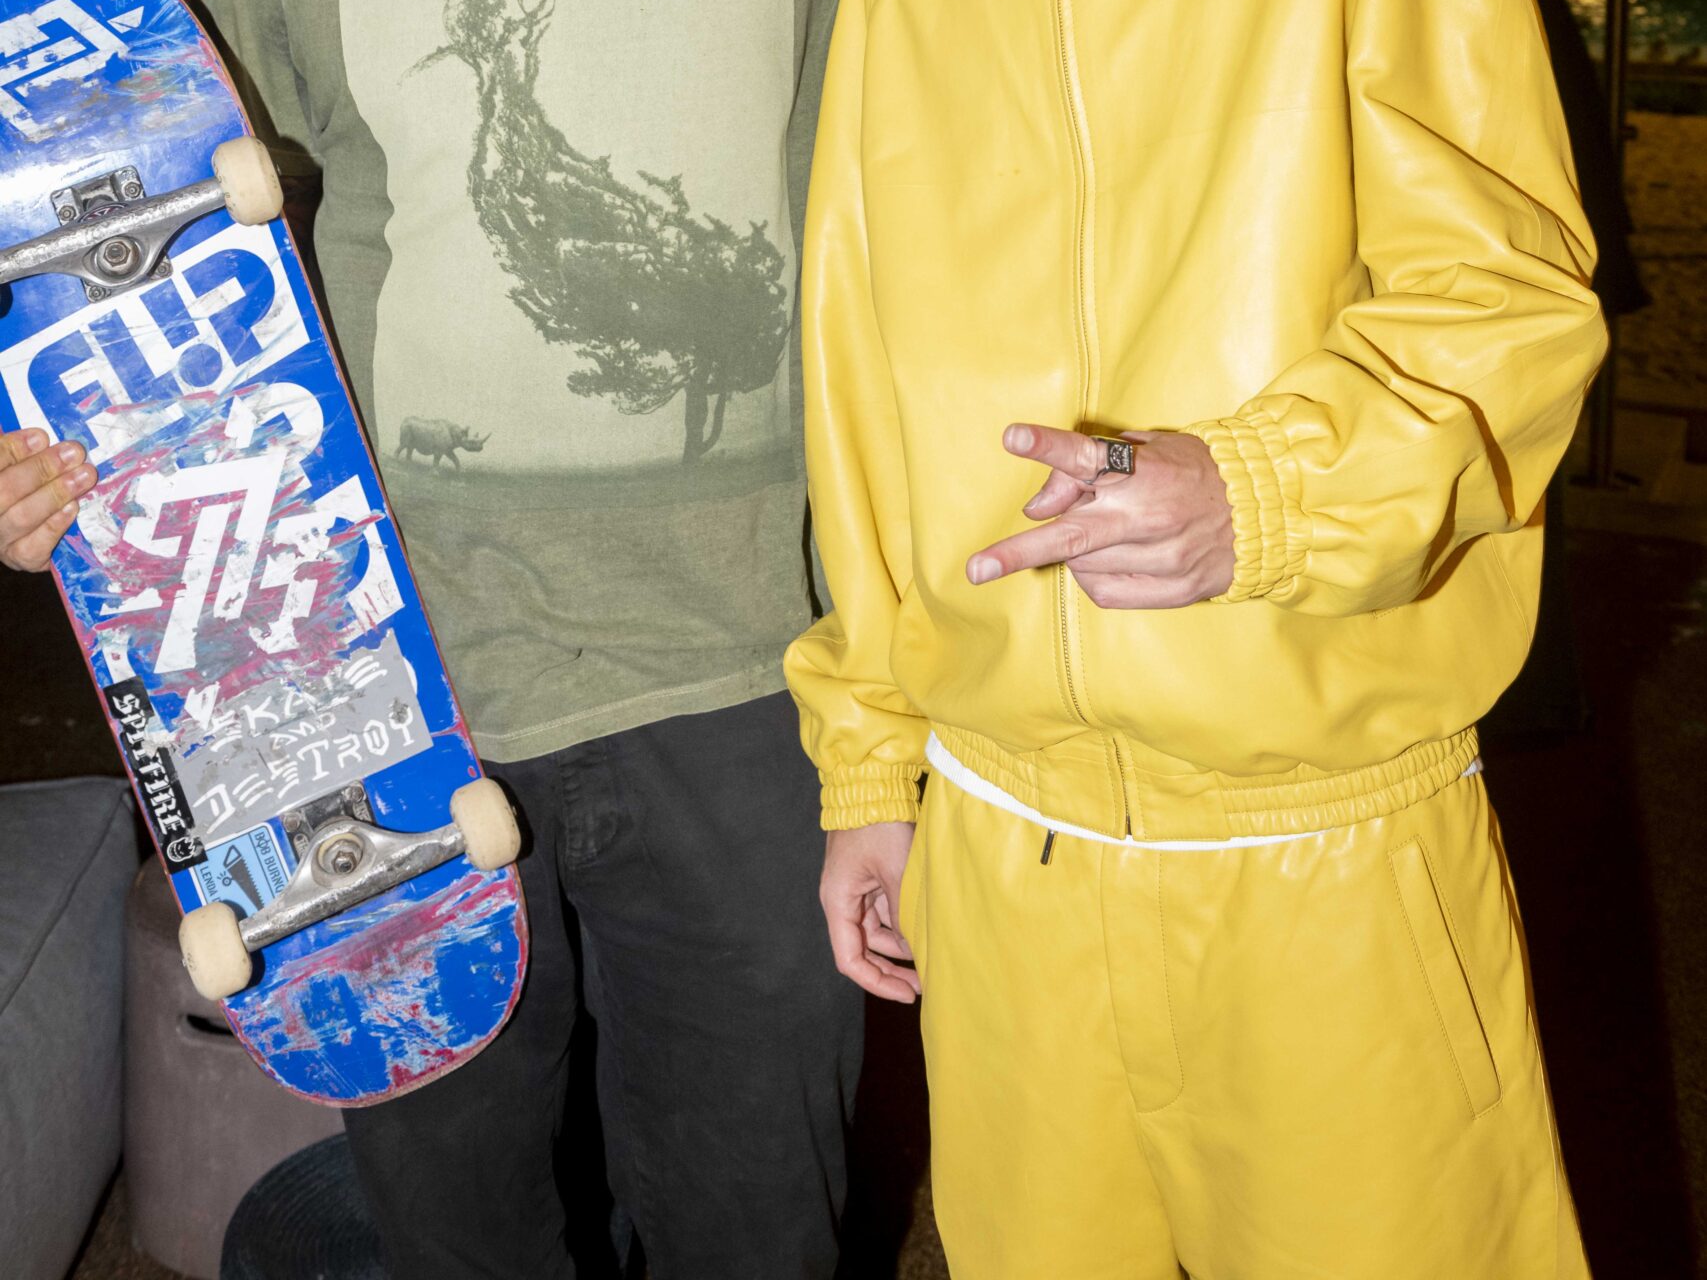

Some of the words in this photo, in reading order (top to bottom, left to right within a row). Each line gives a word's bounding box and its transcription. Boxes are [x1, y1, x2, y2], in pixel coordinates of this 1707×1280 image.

[27, 247, 277, 455] FLIP
[193, 705, 414, 835] DESTROY
[268, 711, 336, 751] AND
[200, 866, 218, 898] LENDA
